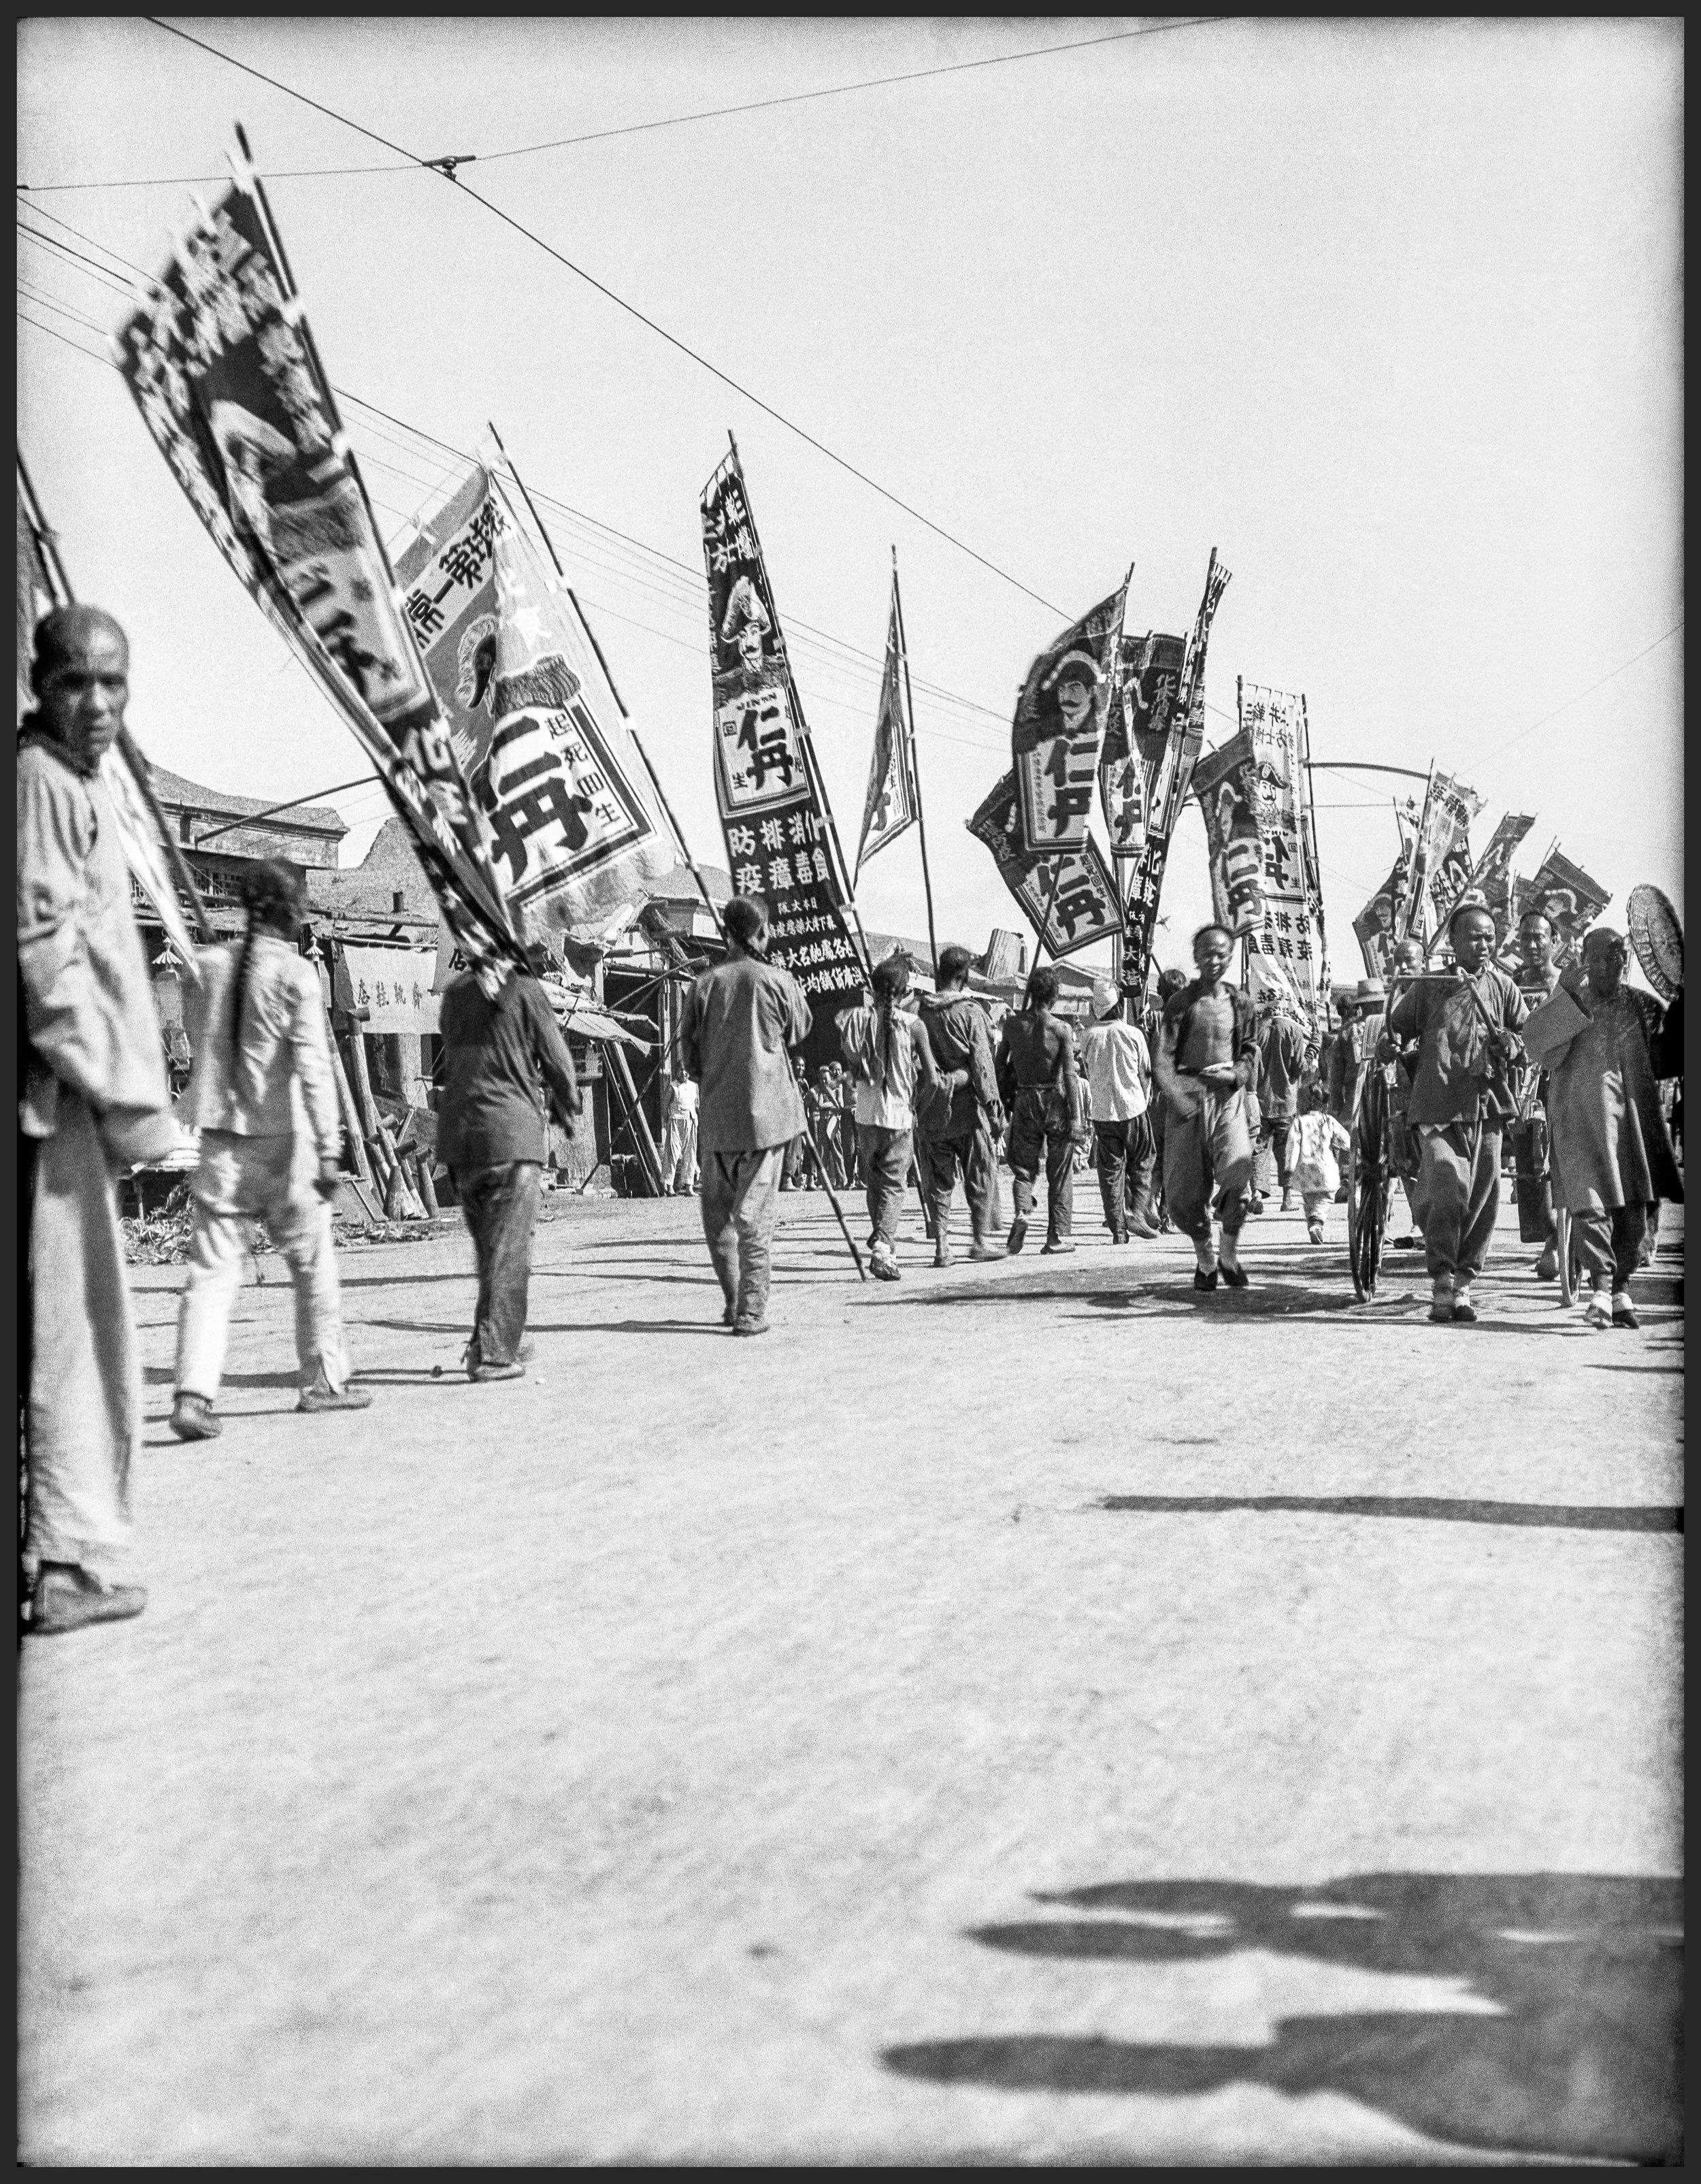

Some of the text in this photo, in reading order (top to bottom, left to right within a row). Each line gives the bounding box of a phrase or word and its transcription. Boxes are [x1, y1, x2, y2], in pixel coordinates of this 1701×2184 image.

[544, 713, 621, 828] 起死回生
[737, 705, 794, 791] 仁丹
[1044, 738, 1100, 838] 仁丹
[727, 824, 765, 895] 防疫
[1037, 855, 1106, 941] 仁丹
[777, 896, 818, 915] 日本大阪
